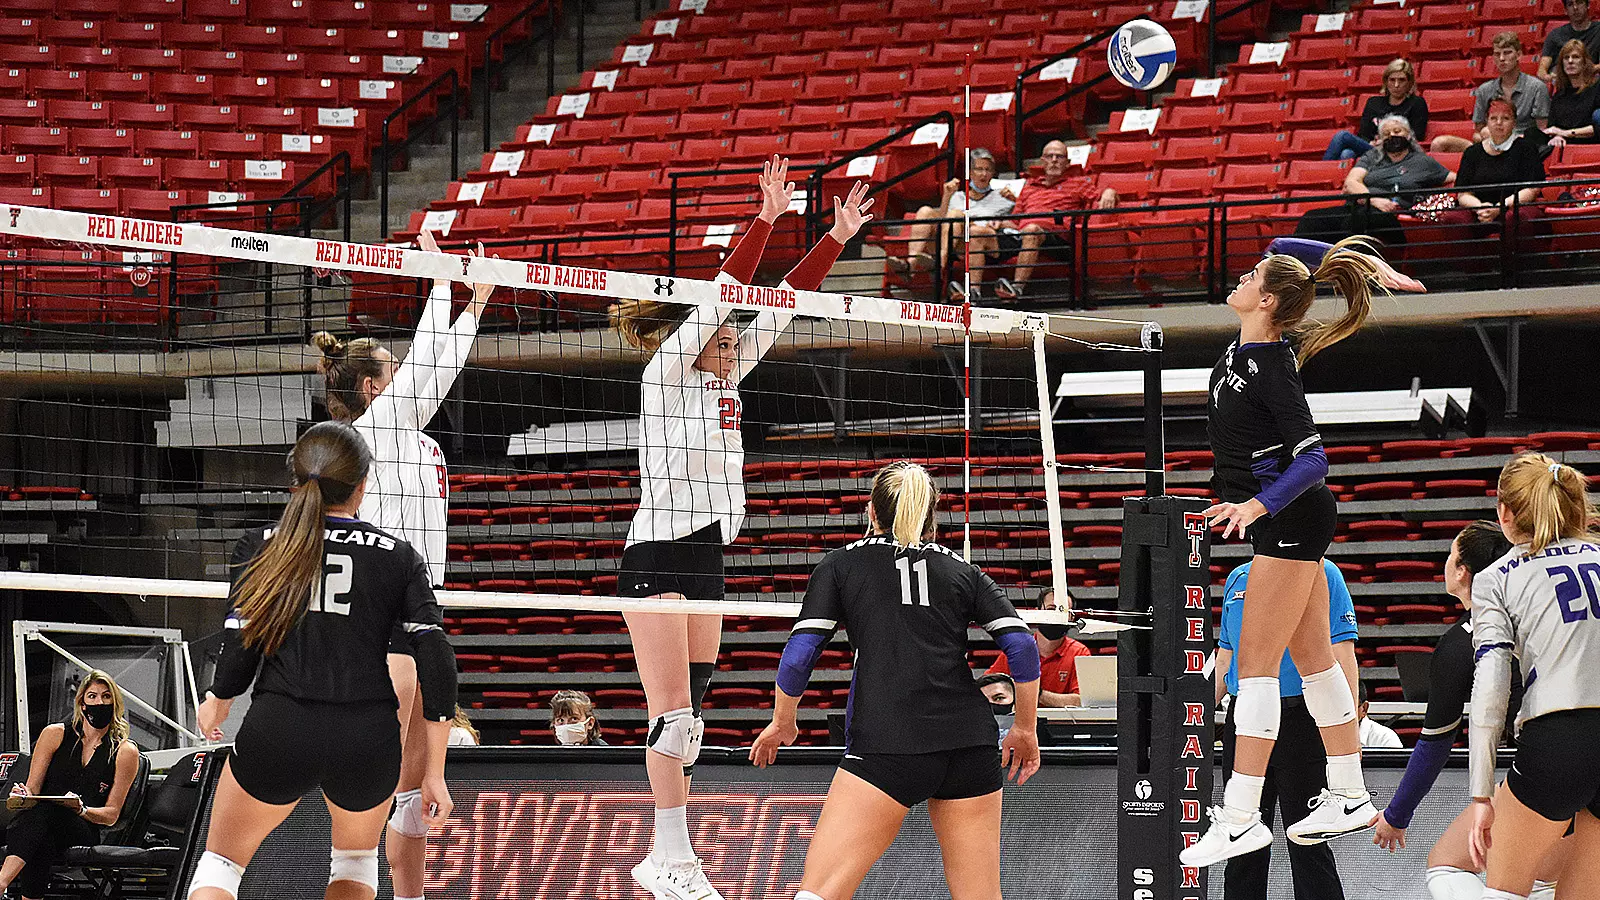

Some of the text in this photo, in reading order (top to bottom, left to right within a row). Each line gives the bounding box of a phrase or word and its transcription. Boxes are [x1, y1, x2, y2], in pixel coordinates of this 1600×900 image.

[87, 215, 183, 246] RED RAIDERS
[231, 236, 269, 253] molten
[316, 241, 404, 270] RED RAIDERS
[133, 272, 147, 282] 109
[526, 263, 607, 291] RED RAIDERS
[720, 283, 796, 309] RED RAIDERS
[900, 302, 921, 321] RED
[1498, 543, 1600, 575] WILDCA
[309, 553, 353, 616] 12
[895, 556, 930, 607] 11
[1545, 563, 1600, 624] 20
[1183, 584, 1206, 674] RED
[1179, 702, 1206, 900] RAIDER
